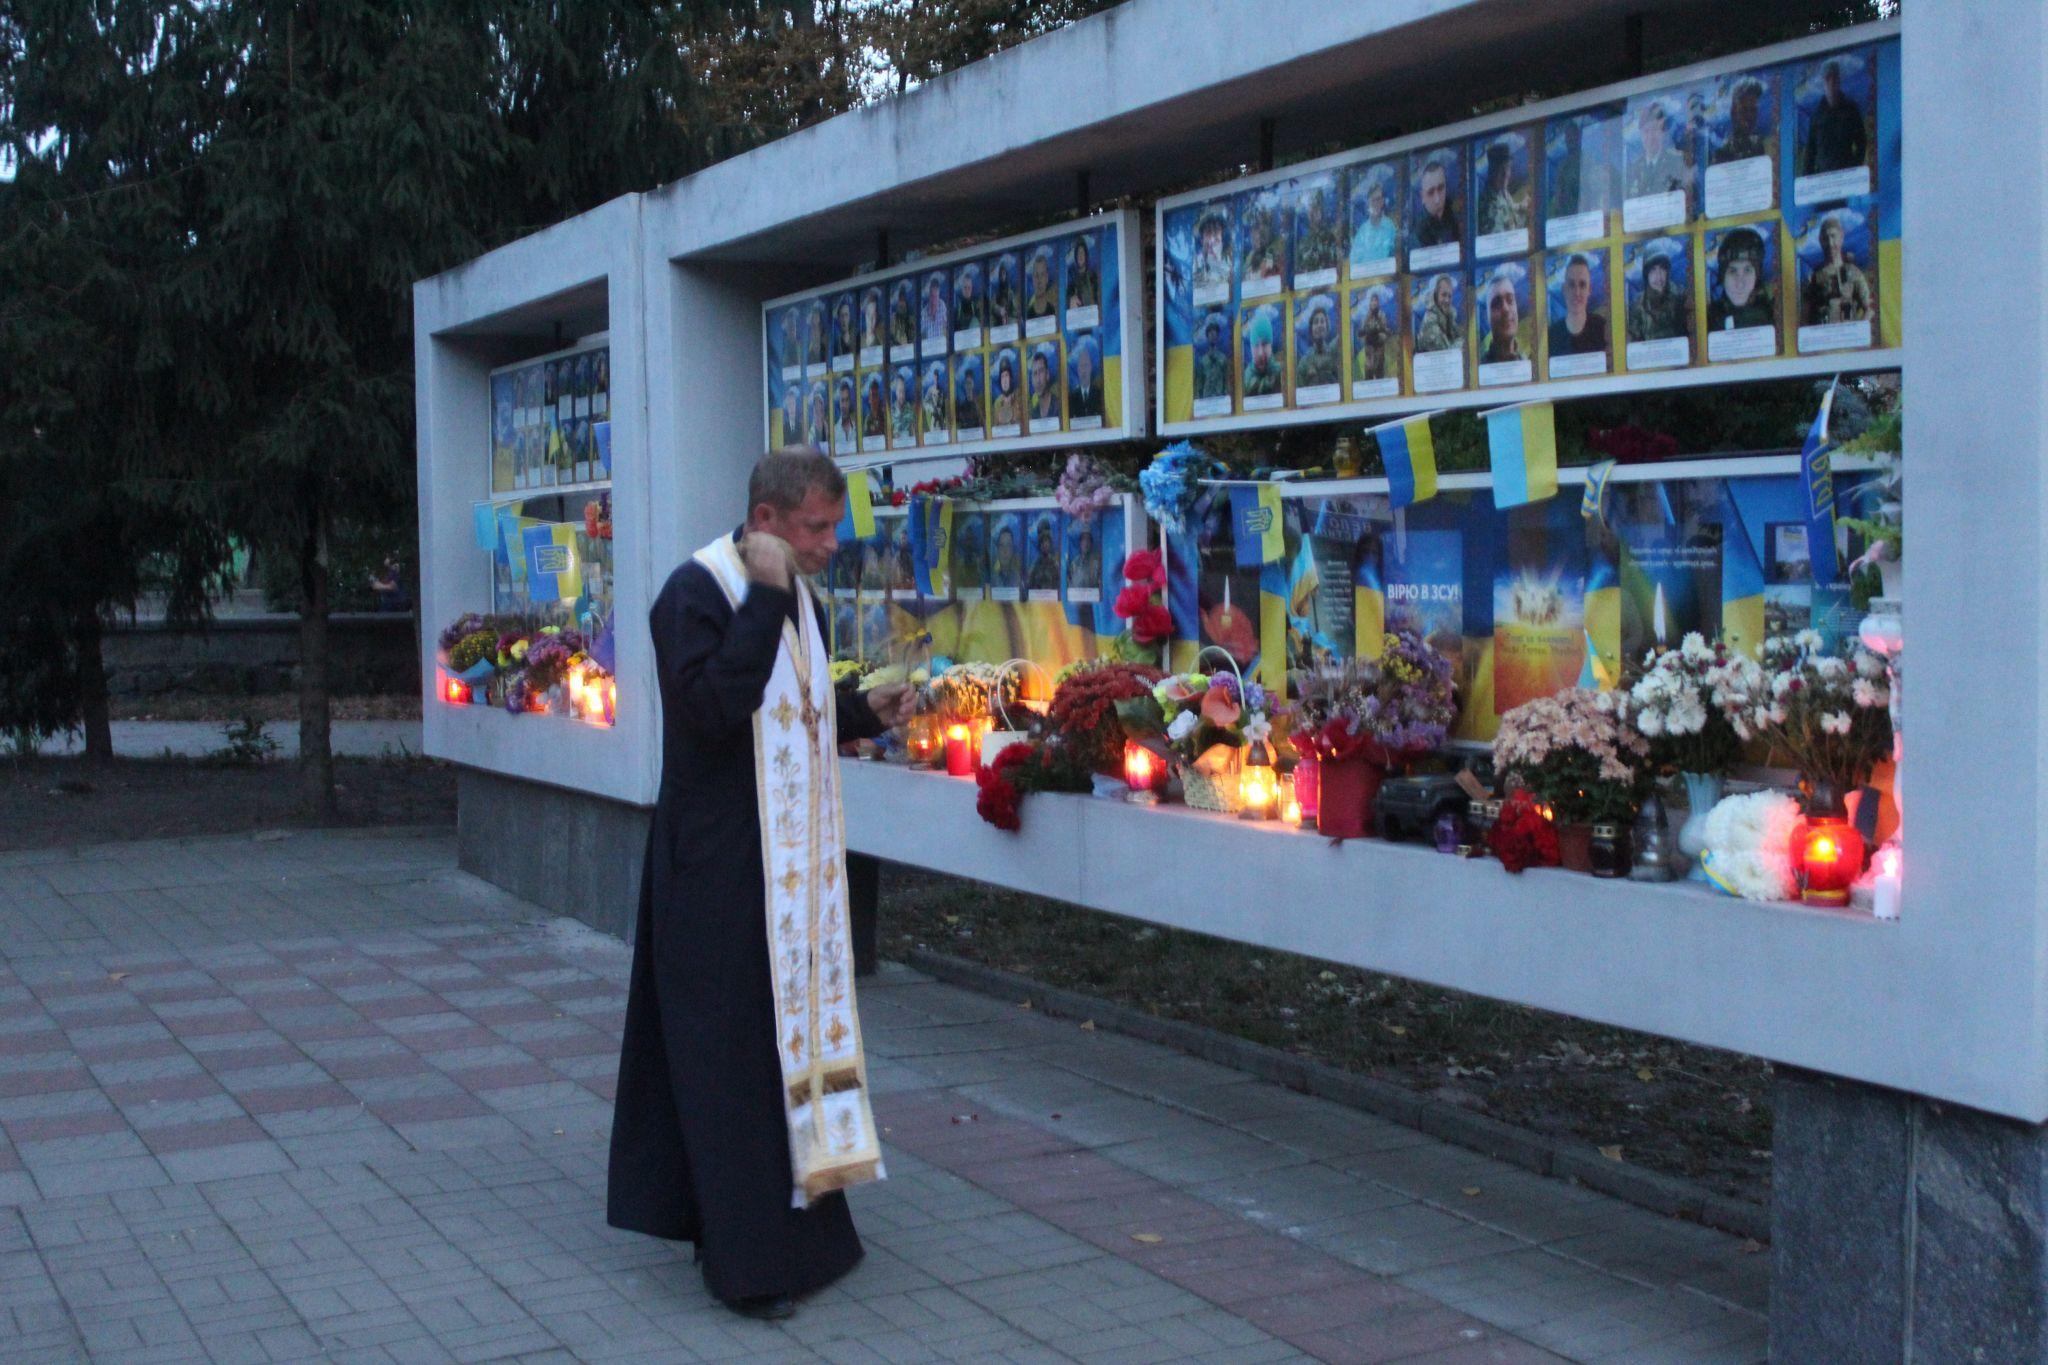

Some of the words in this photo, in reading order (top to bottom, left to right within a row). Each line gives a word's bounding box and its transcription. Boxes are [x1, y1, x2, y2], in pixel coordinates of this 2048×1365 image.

[1387, 584, 1419, 600] ВІРЮ
[1421, 584, 1429, 600] В
[1431, 584, 1459, 600] ЗСУ!
